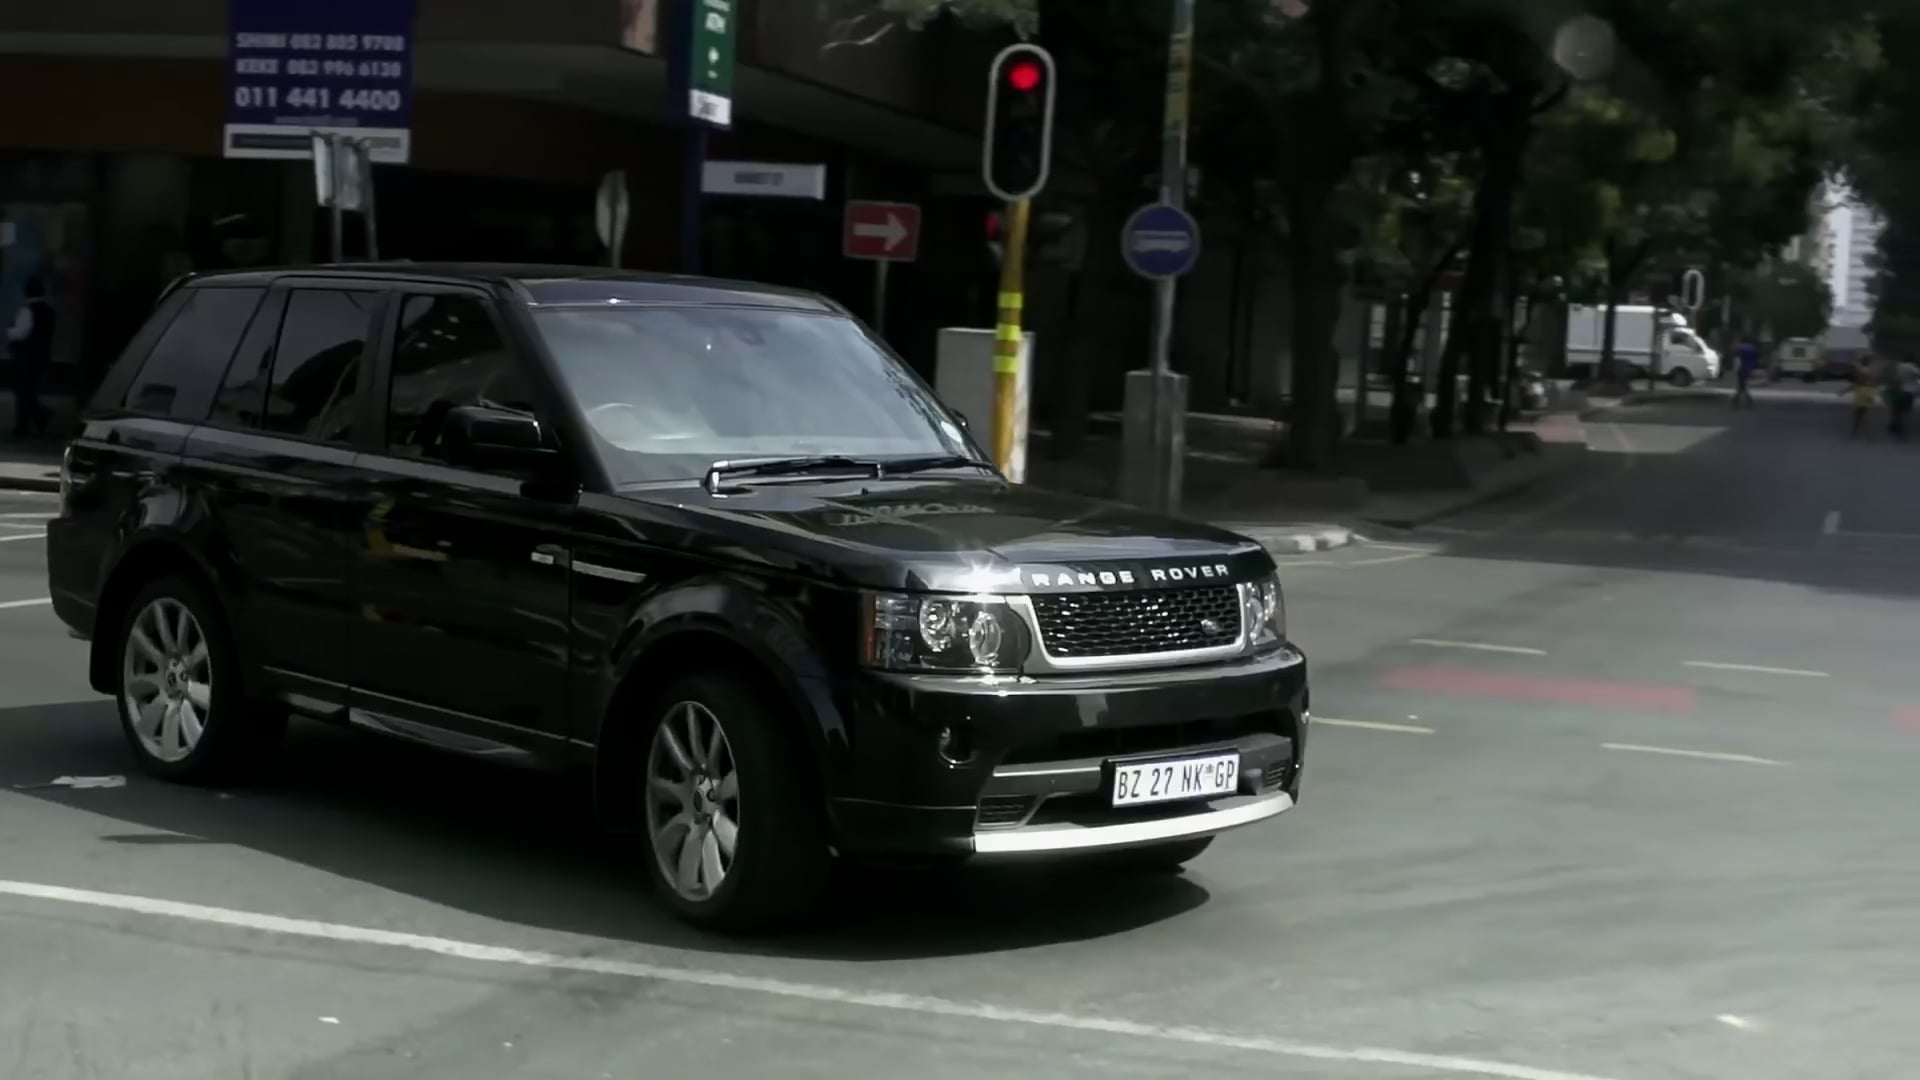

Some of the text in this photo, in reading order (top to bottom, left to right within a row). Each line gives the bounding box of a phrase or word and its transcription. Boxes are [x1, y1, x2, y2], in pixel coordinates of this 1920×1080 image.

[235, 86, 401, 111] 011 441 4400
[1031, 564, 1229, 586] RANGE ROVER
[1117, 760, 1236, 799] BZ 27 NK GP
